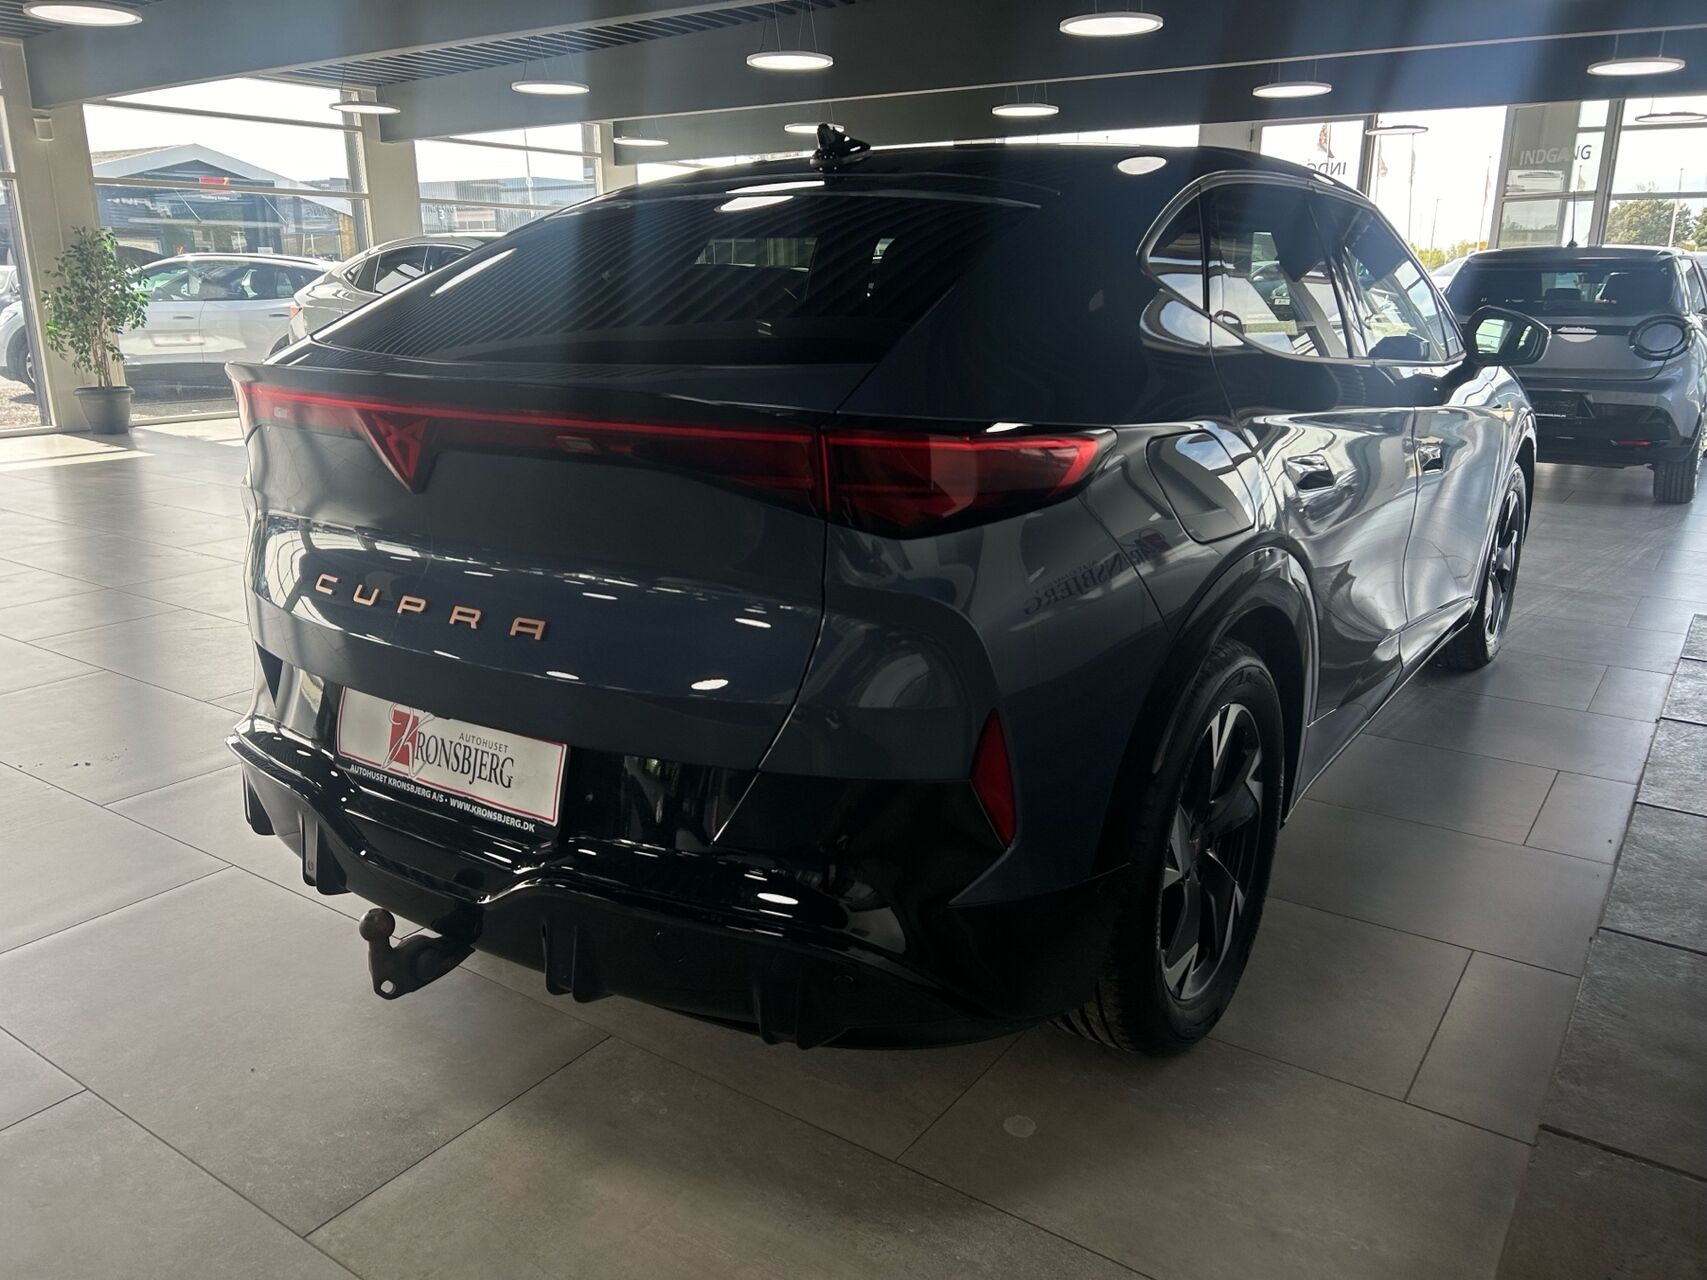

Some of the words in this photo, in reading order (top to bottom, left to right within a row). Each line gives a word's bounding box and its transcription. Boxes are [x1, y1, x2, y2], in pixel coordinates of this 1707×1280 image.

[1519, 144, 1592, 166] INDGANG
[315, 573, 546, 641] CUPRA
[458, 732, 509, 754] AUTOHUSET
[349, 764, 388, 784] AUTOHUSET
[387, 776, 431, 799] KRONSBJERG
[431, 791, 444, 803] A/S
[449, 797, 535, 833] WWW.KRONSBJERG.DK
